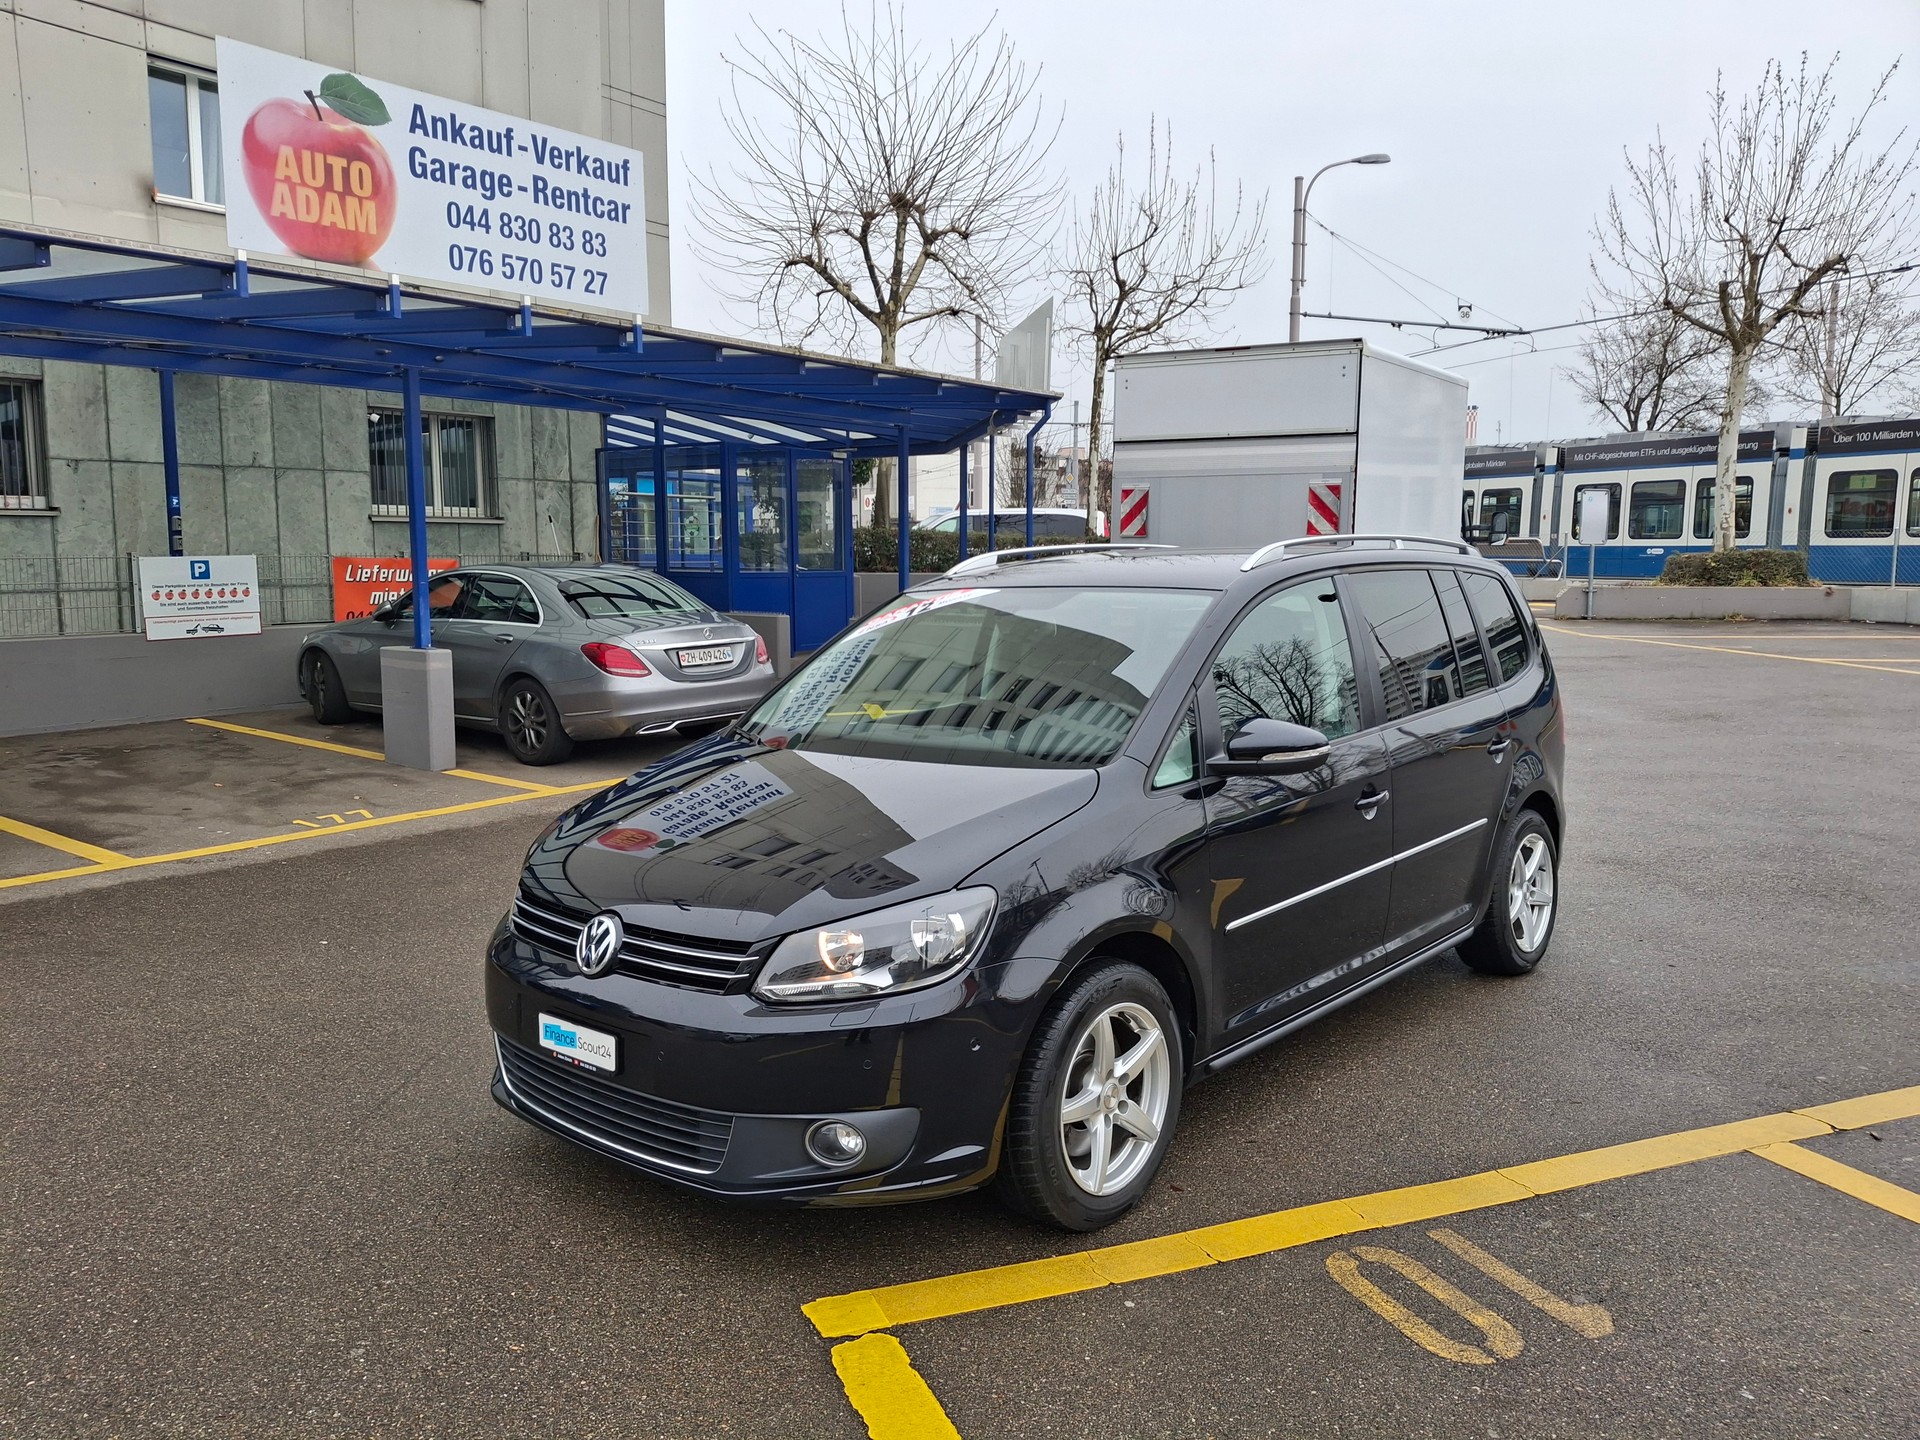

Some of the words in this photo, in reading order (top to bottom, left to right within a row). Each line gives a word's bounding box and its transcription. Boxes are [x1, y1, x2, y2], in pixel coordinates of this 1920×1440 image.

[274, 144, 373, 198] AUTO
[408, 103, 630, 187] Ankauf-Verkauf
[270, 181, 377, 235] ADAM
[408, 146, 631, 224] Garage-Rentcar
[446, 201, 491, 234] 044
[499, 212, 541, 244] 830
[549, 222, 575, 251] 83
[581, 229, 607, 257] 83
[449, 243, 494, 276] 076
[501, 253, 543, 285] 570
[550, 262, 576, 290] 57
[583, 268, 608, 296] 27
[1573, 453, 1584, 461] Mit
[1640, 448, 1656, 457] ETFs
[1657, 447, 1671, 455] und
[1833, 433, 1853, 444] Über
[1855, 431, 1871, 441] 100
[1873, 430, 1914, 440] Milliarden
[193, 562, 206, 578] P
[292, 809, 374, 828] 177
